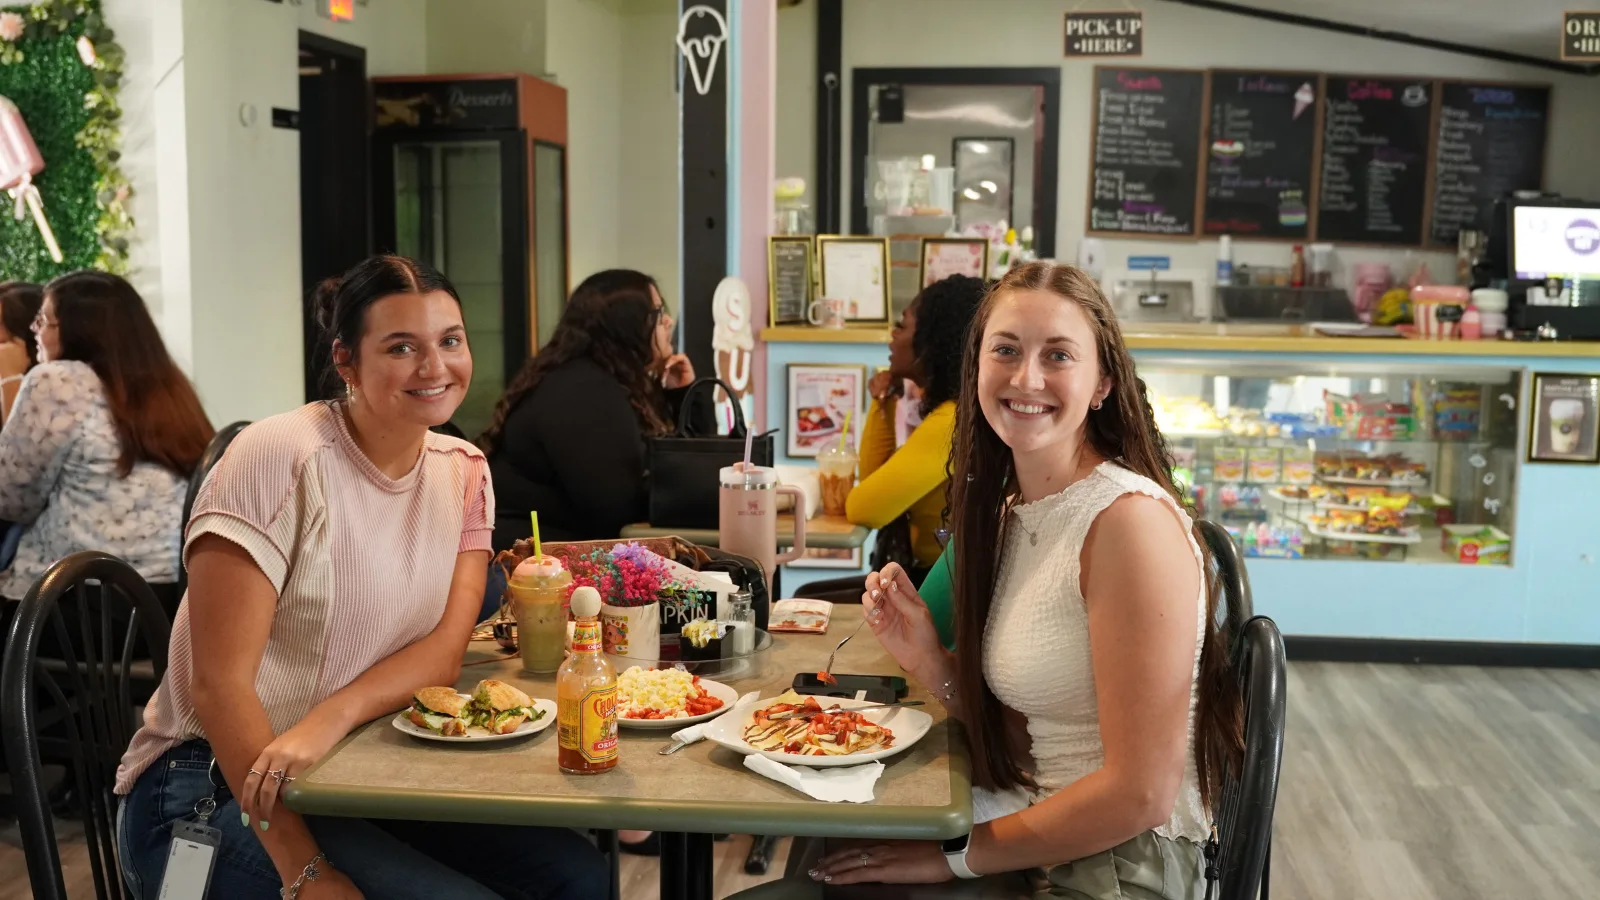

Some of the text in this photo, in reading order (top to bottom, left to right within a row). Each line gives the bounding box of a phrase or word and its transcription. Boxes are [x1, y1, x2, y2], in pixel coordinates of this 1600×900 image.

[1066, 19, 1142, 36] PICK-UP
[1566, 18, 1600, 36] OR
[660, 603, 708, 624] PKIN
